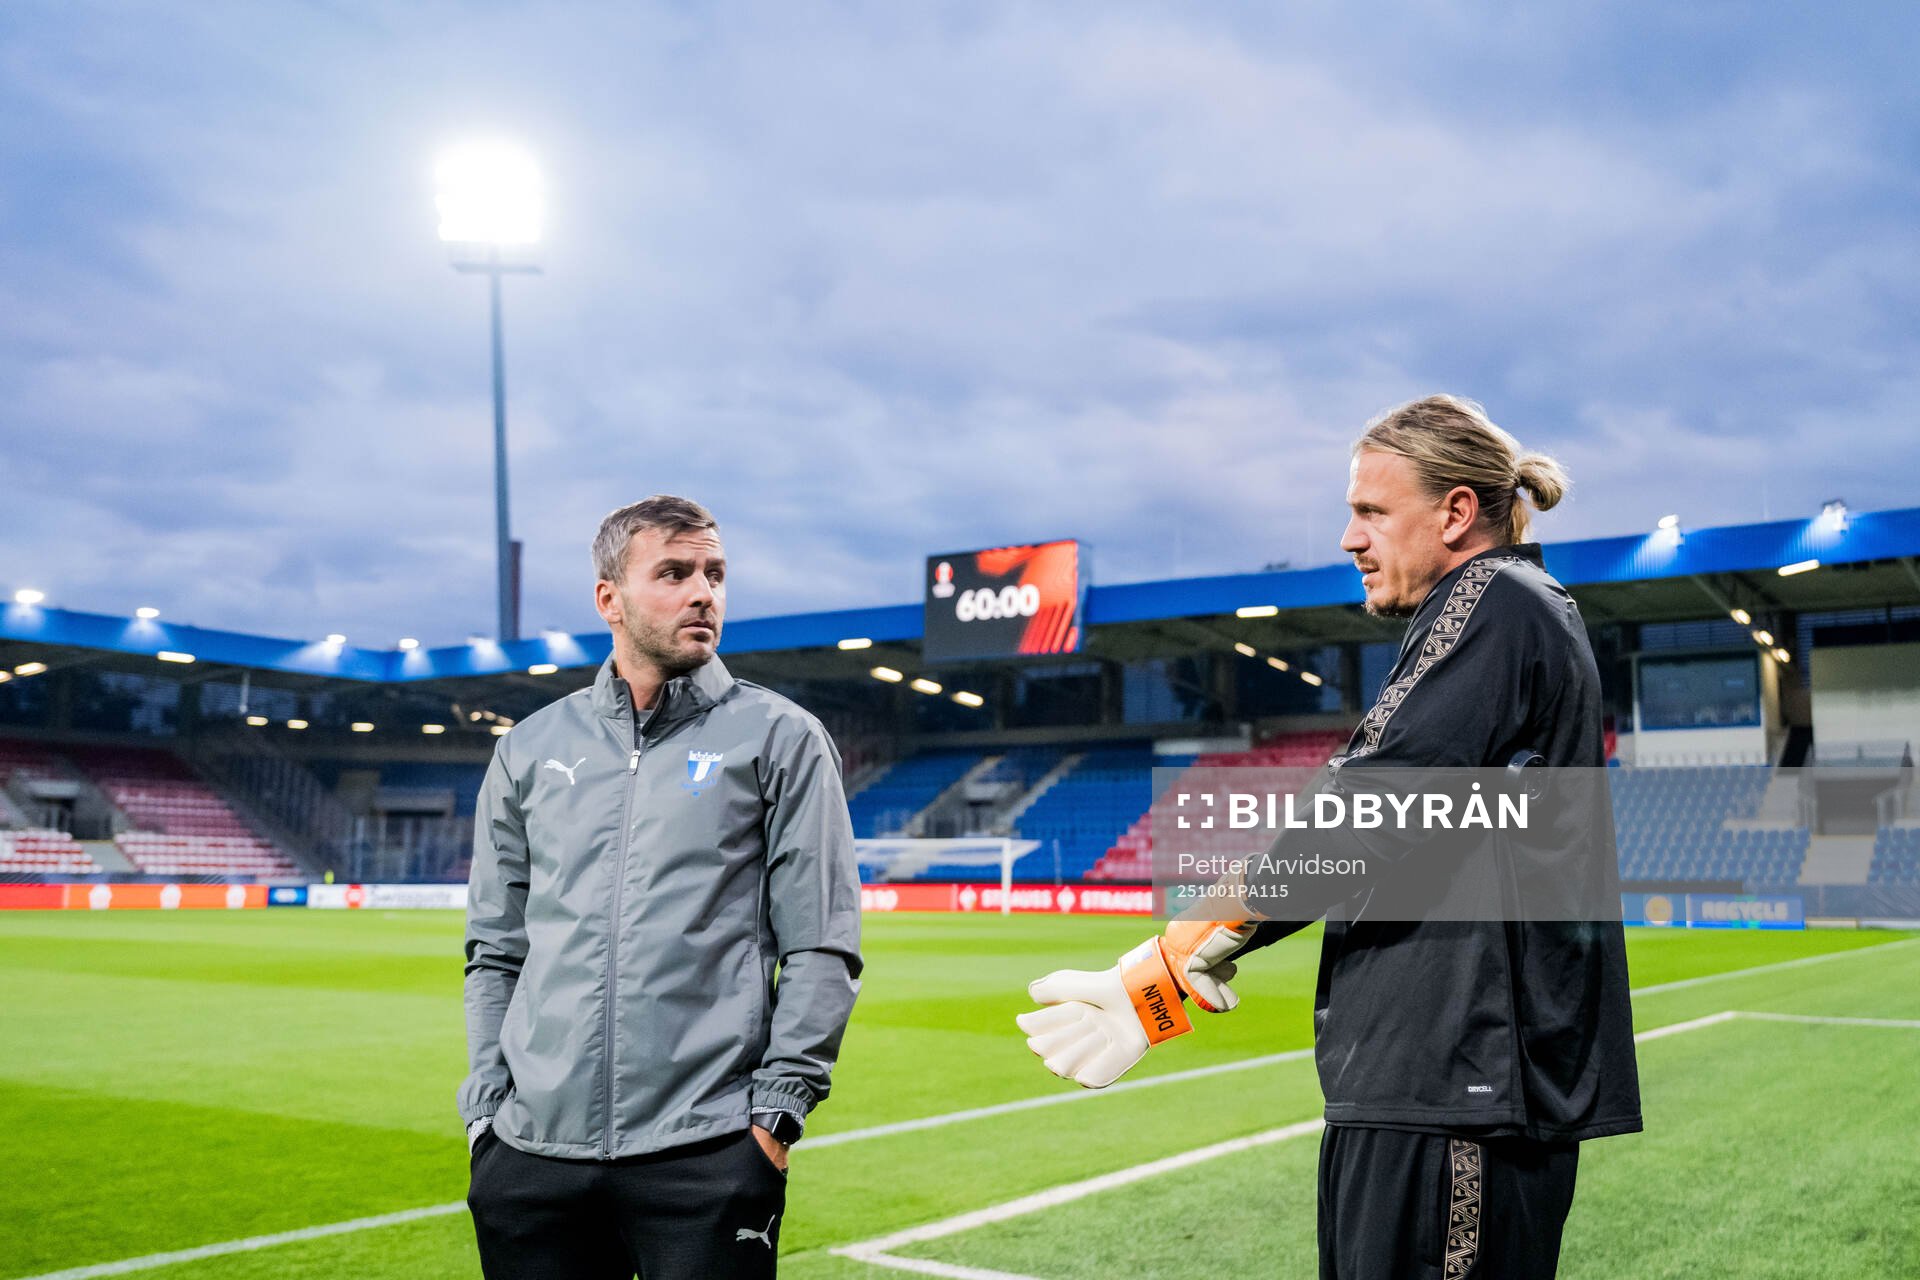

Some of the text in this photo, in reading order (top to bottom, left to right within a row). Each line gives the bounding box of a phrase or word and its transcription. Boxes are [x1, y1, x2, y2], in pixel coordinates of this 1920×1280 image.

[956, 584, 1039, 622] 60:00
[1702, 901, 1788, 920] RECYCLE
[1142, 984, 1175, 1032] DAHLIN
[1468, 1085, 1492, 1093] DRYCELL
